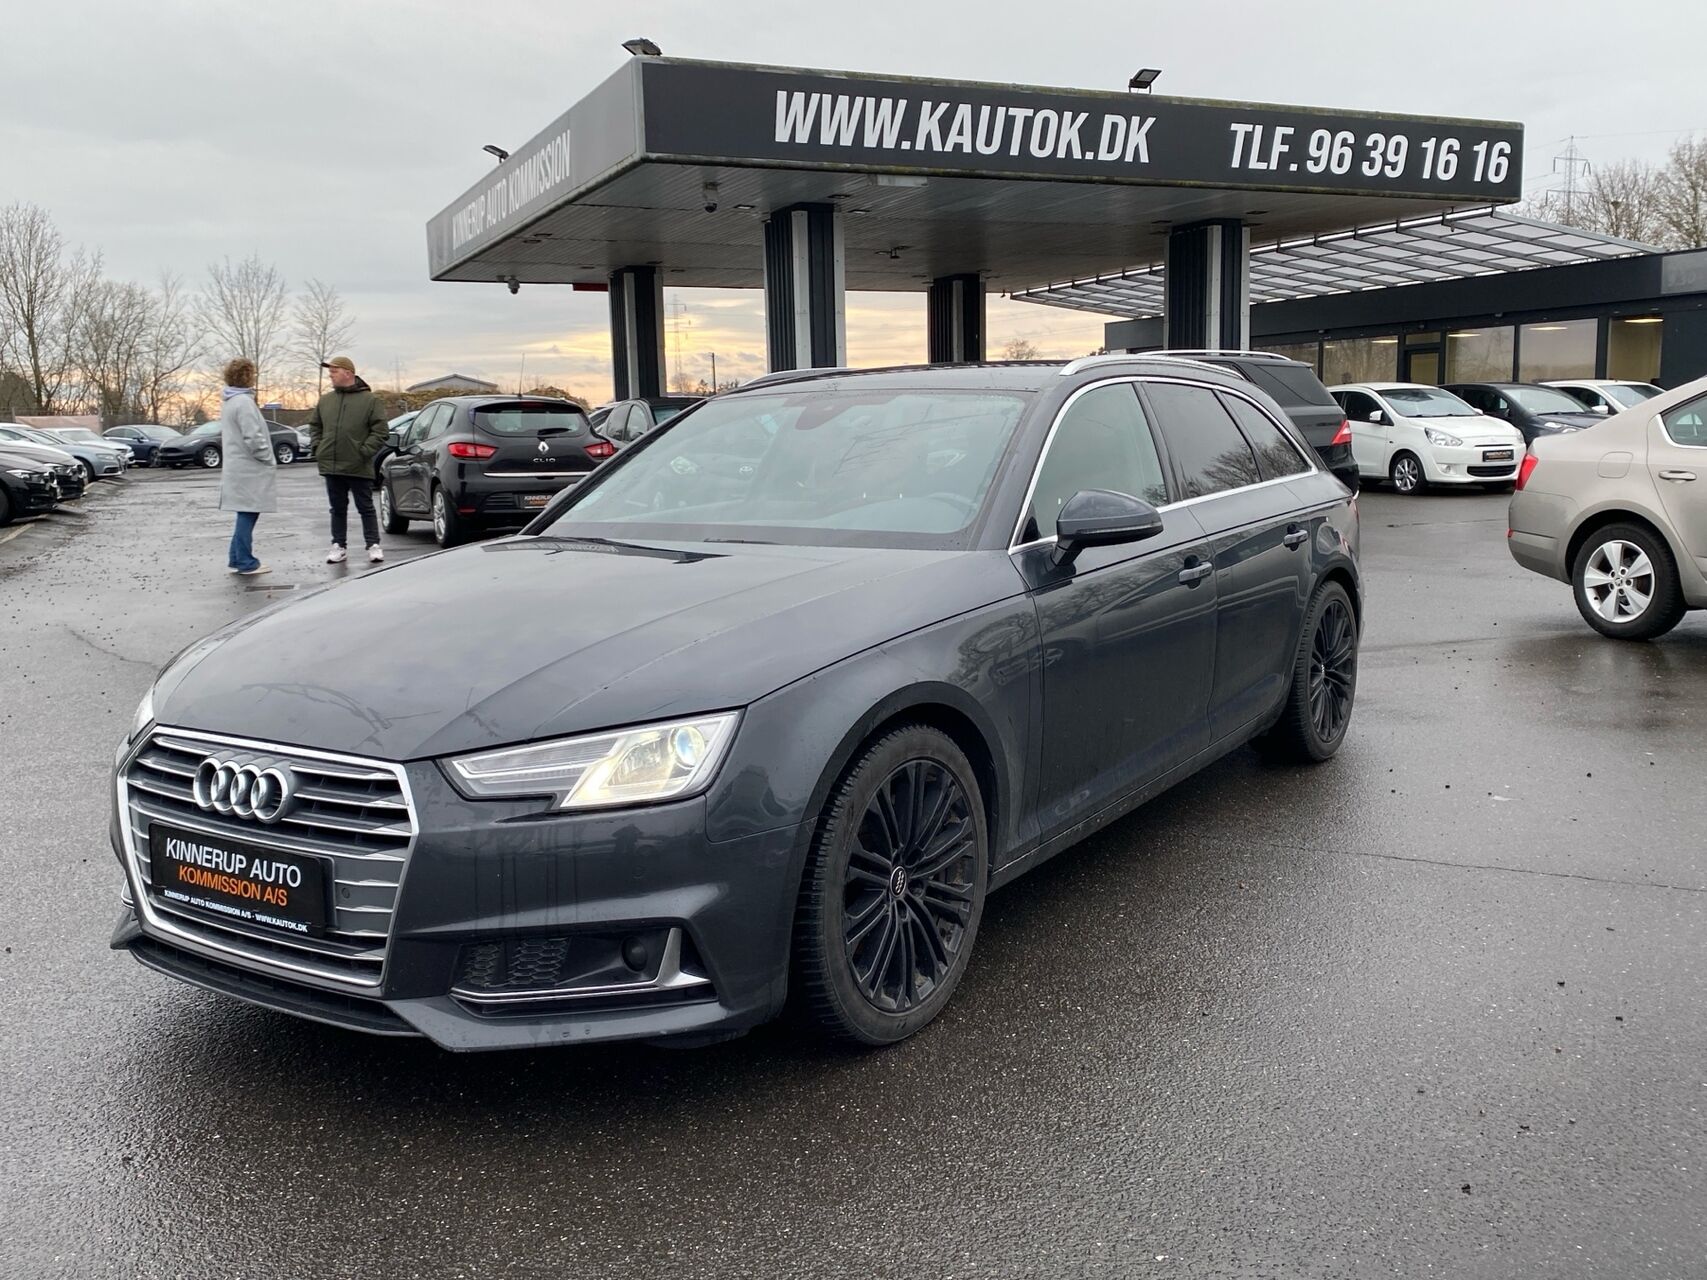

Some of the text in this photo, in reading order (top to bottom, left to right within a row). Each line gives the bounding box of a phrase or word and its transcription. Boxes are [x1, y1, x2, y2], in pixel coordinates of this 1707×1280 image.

[775, 90, 1156, 163] WWW.KAUTOK.DK
[1230, 123, 1512, 184] TLF. 96 39 16 16
[452, 129, 571, 250] KINNERUP AUTO KOMMISSION
[165, 837, 302, 888] KINNERUP AUTO
[179, 865, 288, 907] KOMMISSION A/S
[164, 889, 190, 902] KINNERUP
[190, 896, 205, 907] AUTO
[205, 900, 240, 916] KOMMISSION
[240, 909, 252, 919] A/S
[255, 913, 308, 933] WWW.KAUTOK.DK
